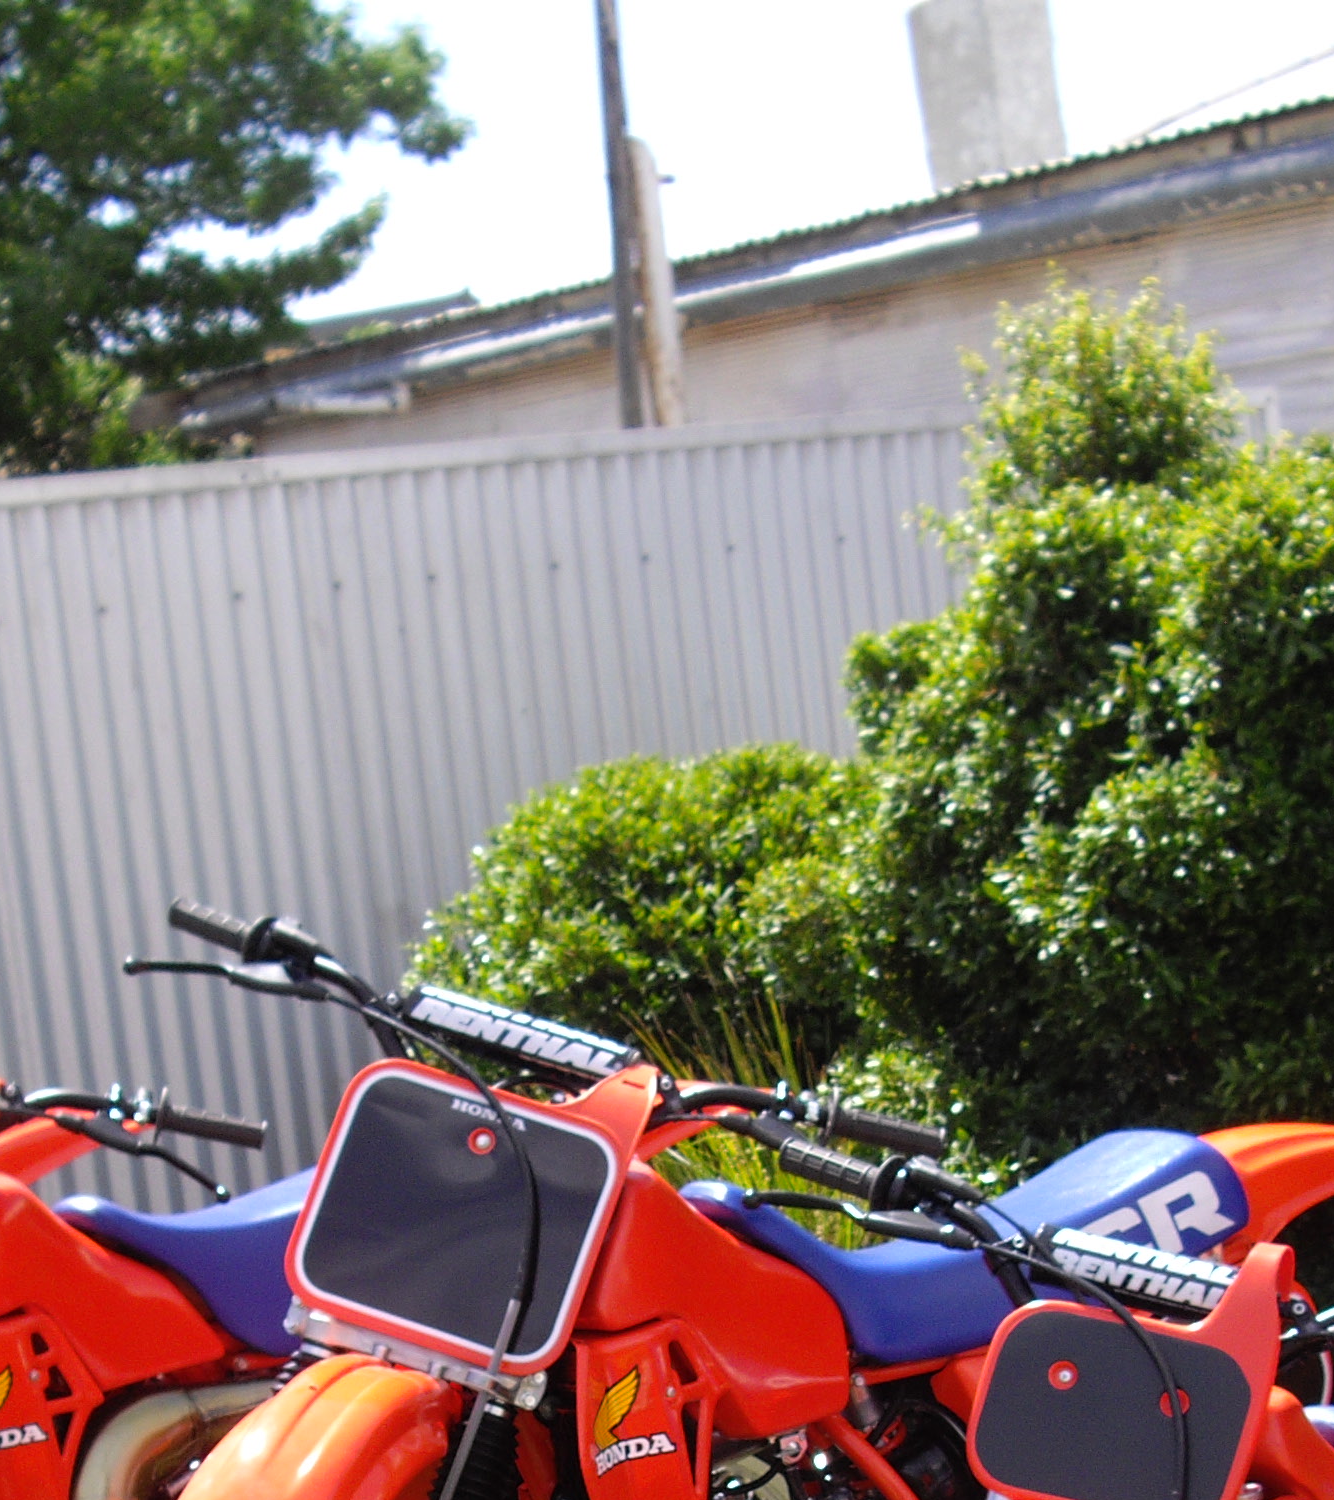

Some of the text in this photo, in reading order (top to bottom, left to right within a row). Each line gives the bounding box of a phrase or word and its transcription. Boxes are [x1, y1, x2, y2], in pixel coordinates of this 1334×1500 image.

[410, 996, 622, 1078] RENTHAL
[451, 1098, 527, 1132] HONA
[595, 1432, 676, 1477] HONDA
